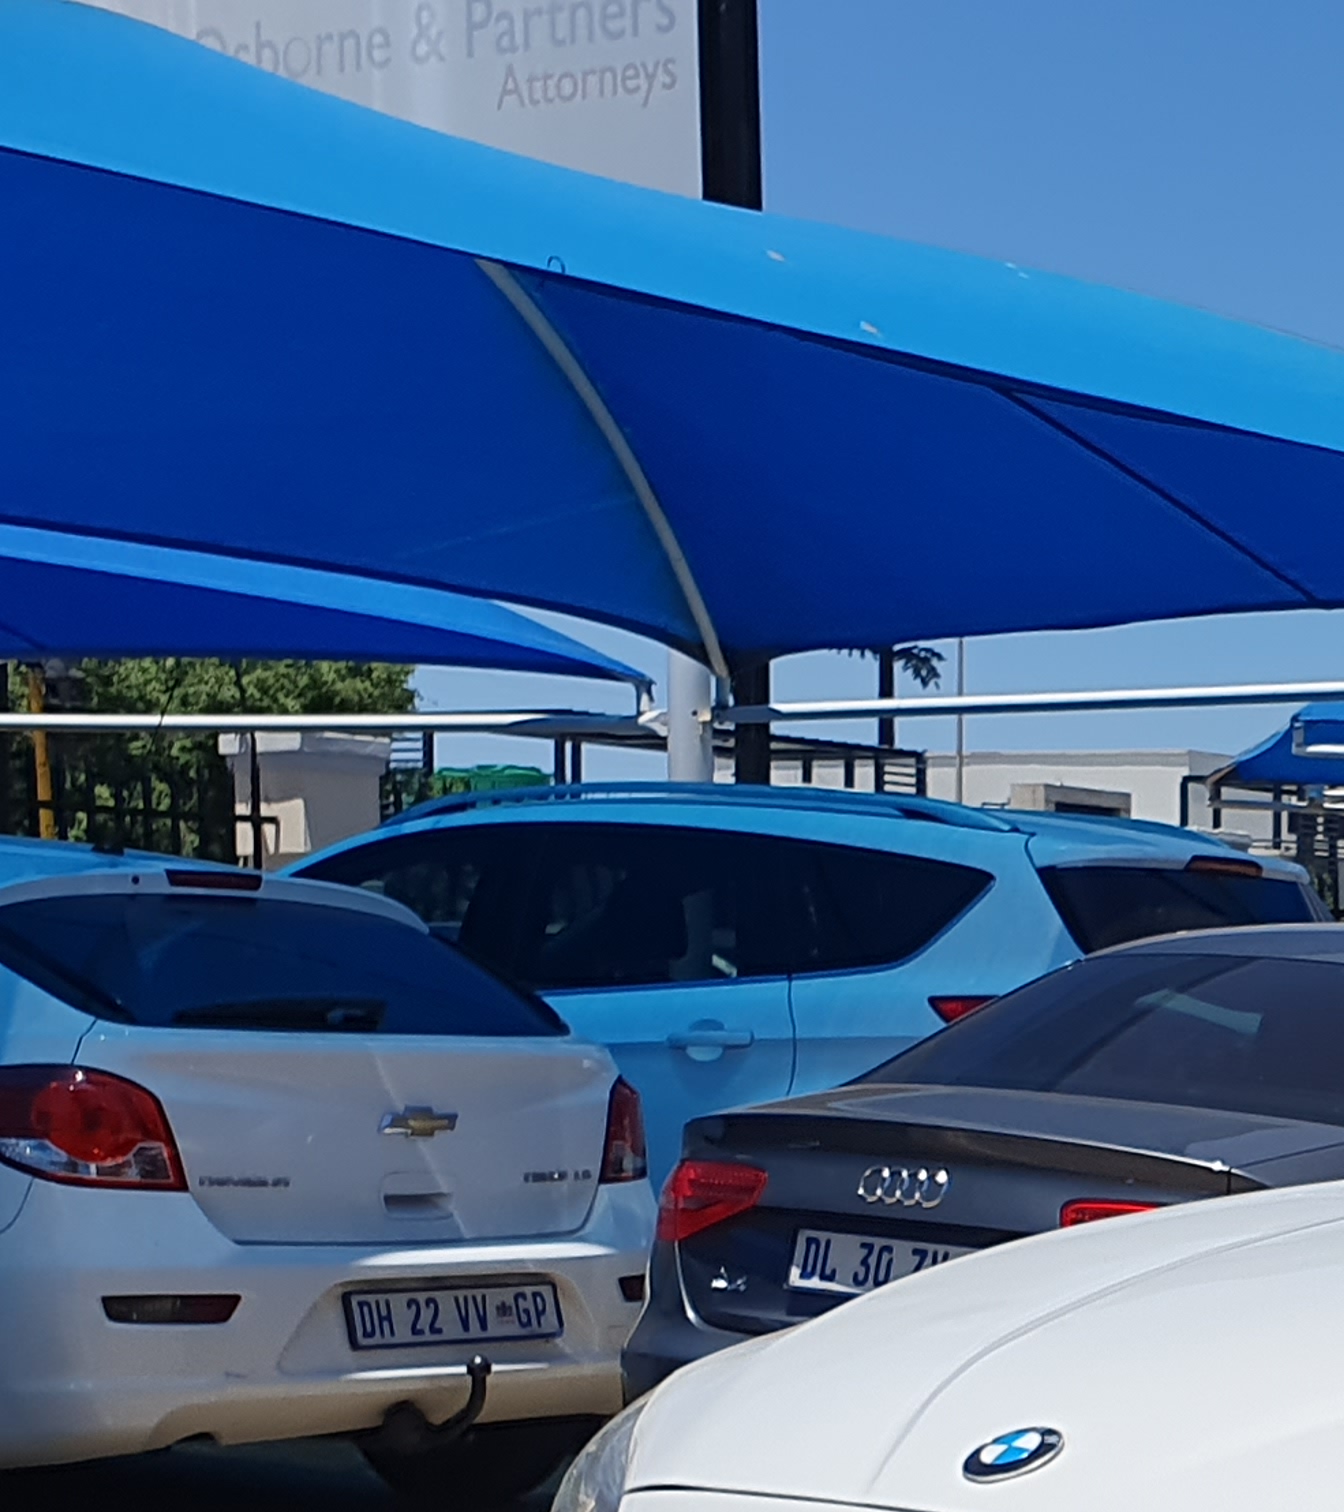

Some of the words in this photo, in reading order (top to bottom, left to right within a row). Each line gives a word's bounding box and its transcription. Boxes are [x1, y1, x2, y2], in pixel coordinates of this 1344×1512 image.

[409, 2, 446, 64] &
[465, 0, 678, 58] Partners
[497, 57, 678, 111] Attorneys
[798, 1236, 837, 1283] DL
[852, 1242, 894, 1287] 30
[356, 1299, 395, 1340] DH
[406, 1296, 443, 1336] 22
[453, 1292, 488, 1333] VV
[513, 1290, 547, 1329] GP
